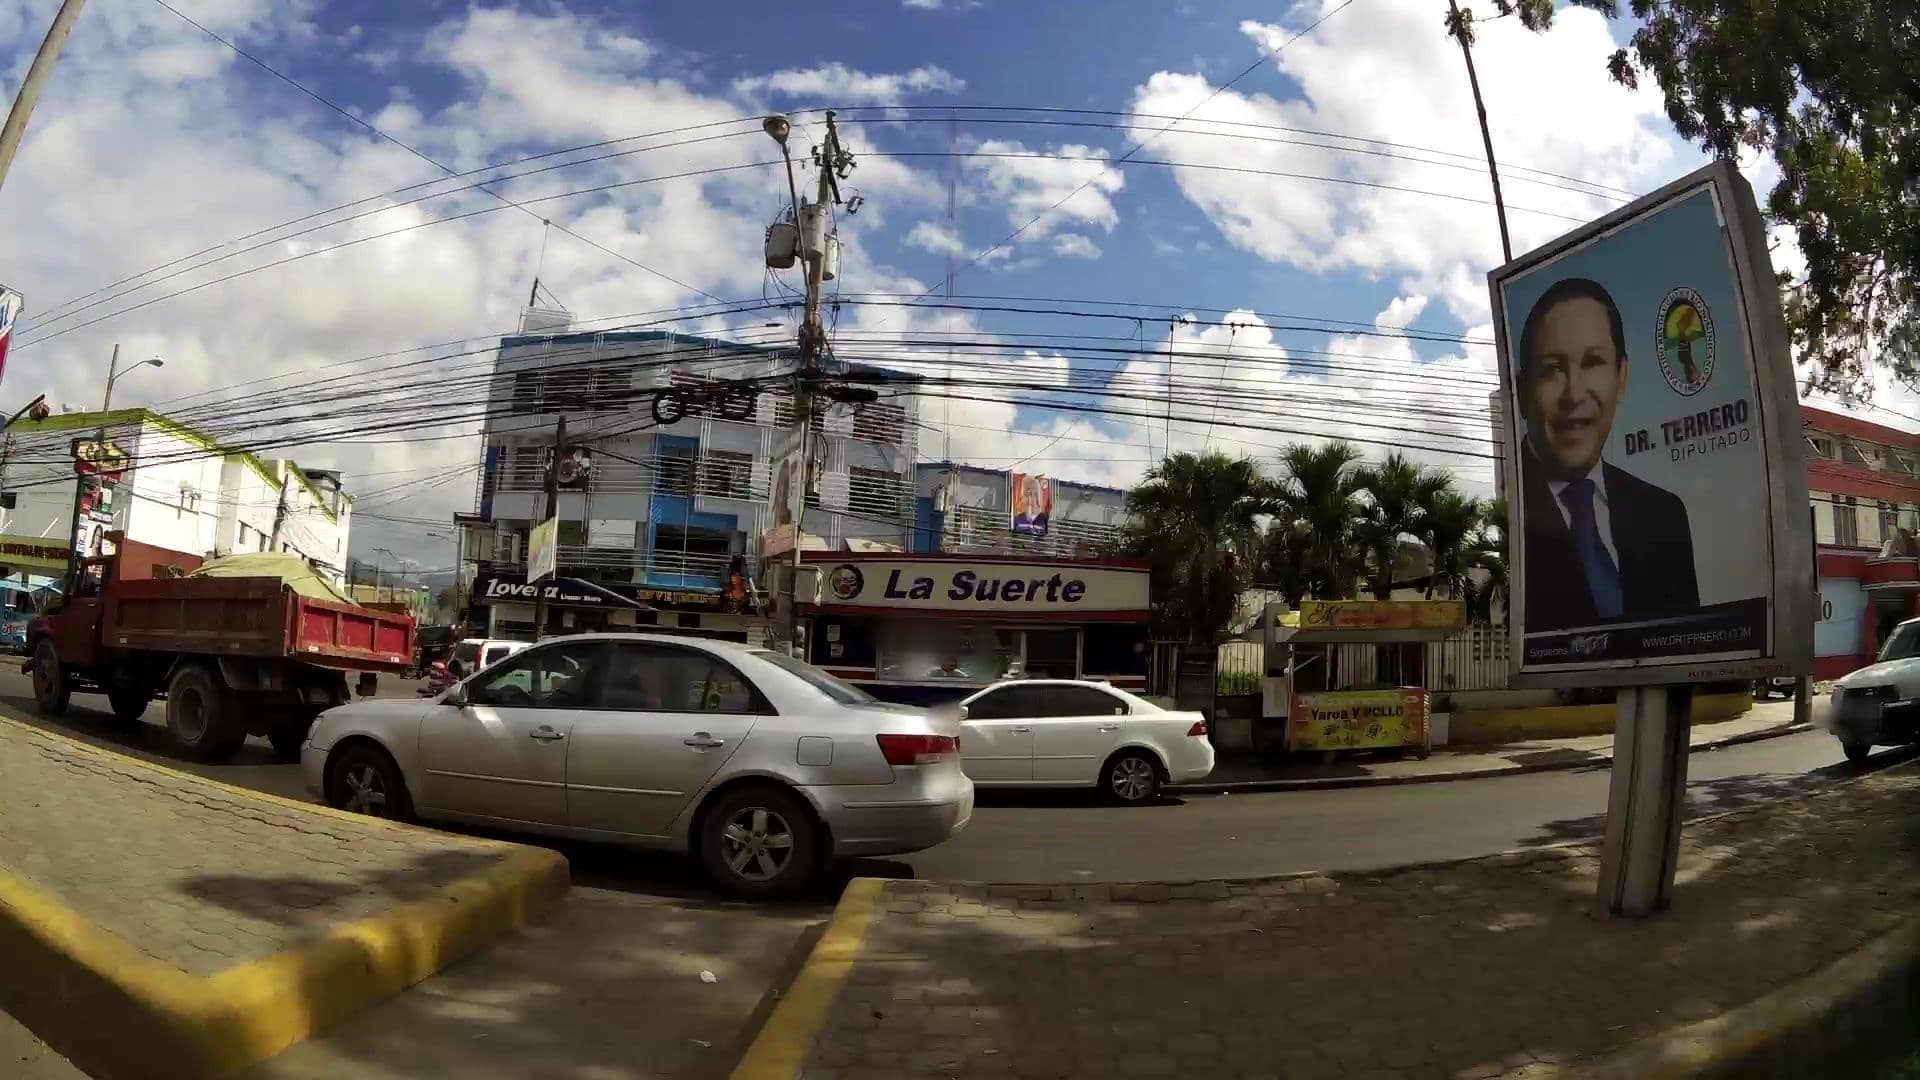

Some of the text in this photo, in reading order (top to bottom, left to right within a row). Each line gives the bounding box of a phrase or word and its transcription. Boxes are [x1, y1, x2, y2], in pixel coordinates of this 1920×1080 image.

[1625, 399, 1749, 456] DR. TERRERO
[1671, 428, 1750, 462] DIPUTADO
[884, 569, 1086, 602] La Suerte
